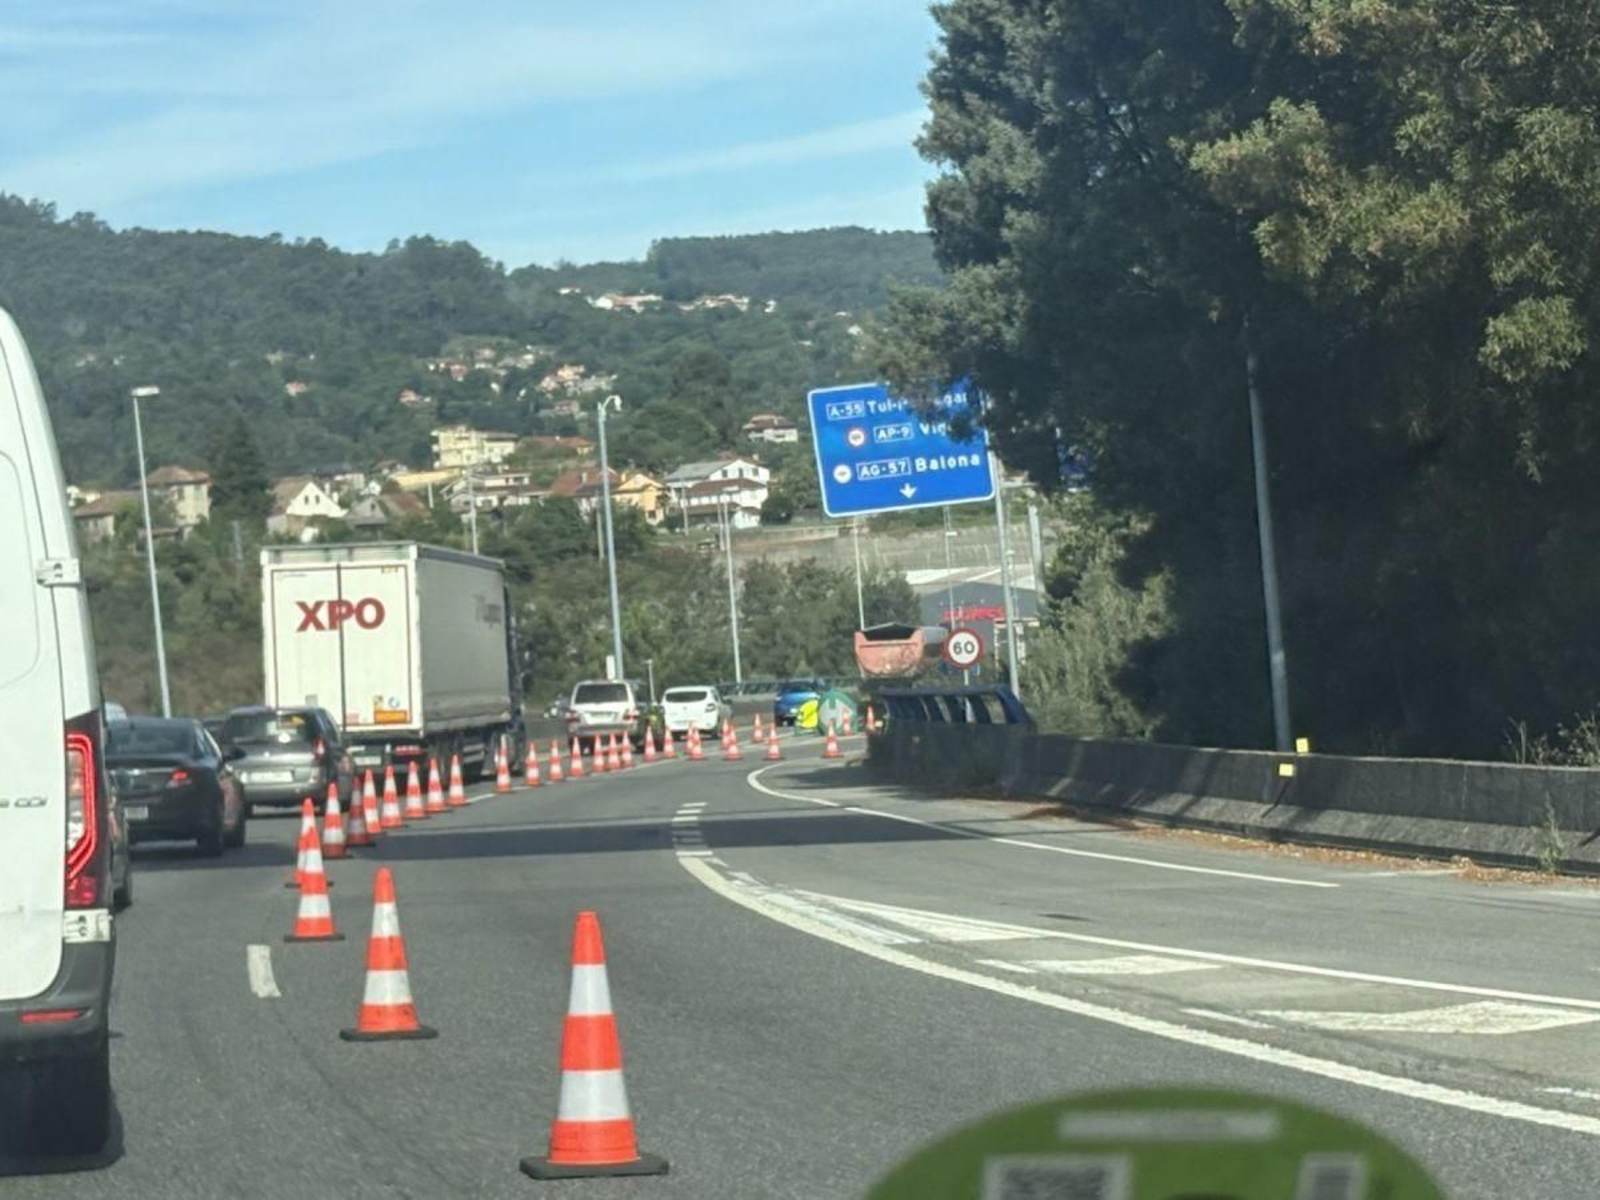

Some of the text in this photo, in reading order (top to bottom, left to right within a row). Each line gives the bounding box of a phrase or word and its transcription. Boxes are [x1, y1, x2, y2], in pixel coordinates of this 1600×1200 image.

[878, 421, 953, 440] AP-9 Vig
[860, 454, 981, 478] AG-57 Baiona
[295, 597, 386, 633] XPO
[953, 641, 975, 655] 60
